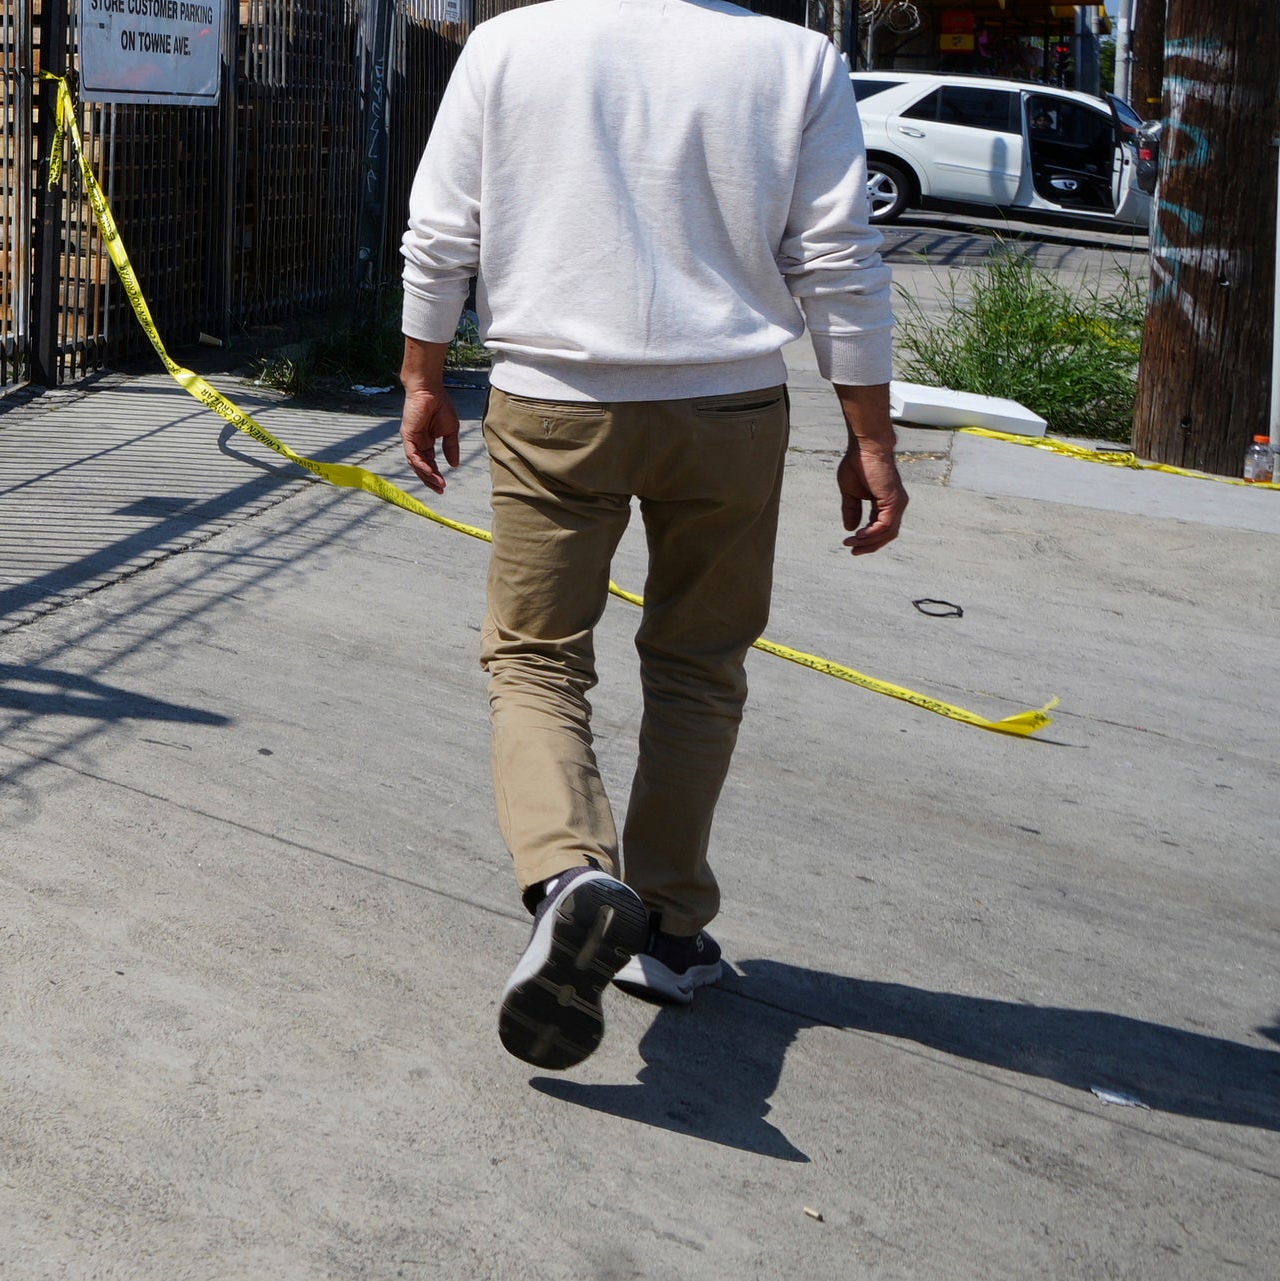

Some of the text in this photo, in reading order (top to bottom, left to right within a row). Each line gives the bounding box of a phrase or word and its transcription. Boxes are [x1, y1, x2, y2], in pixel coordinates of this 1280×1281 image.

[180, 1, 213, 25] PARKING
[120, 29, 191, 56] ON TOWNE AVE.
[201, 388, 234, 416] CRUZAR
